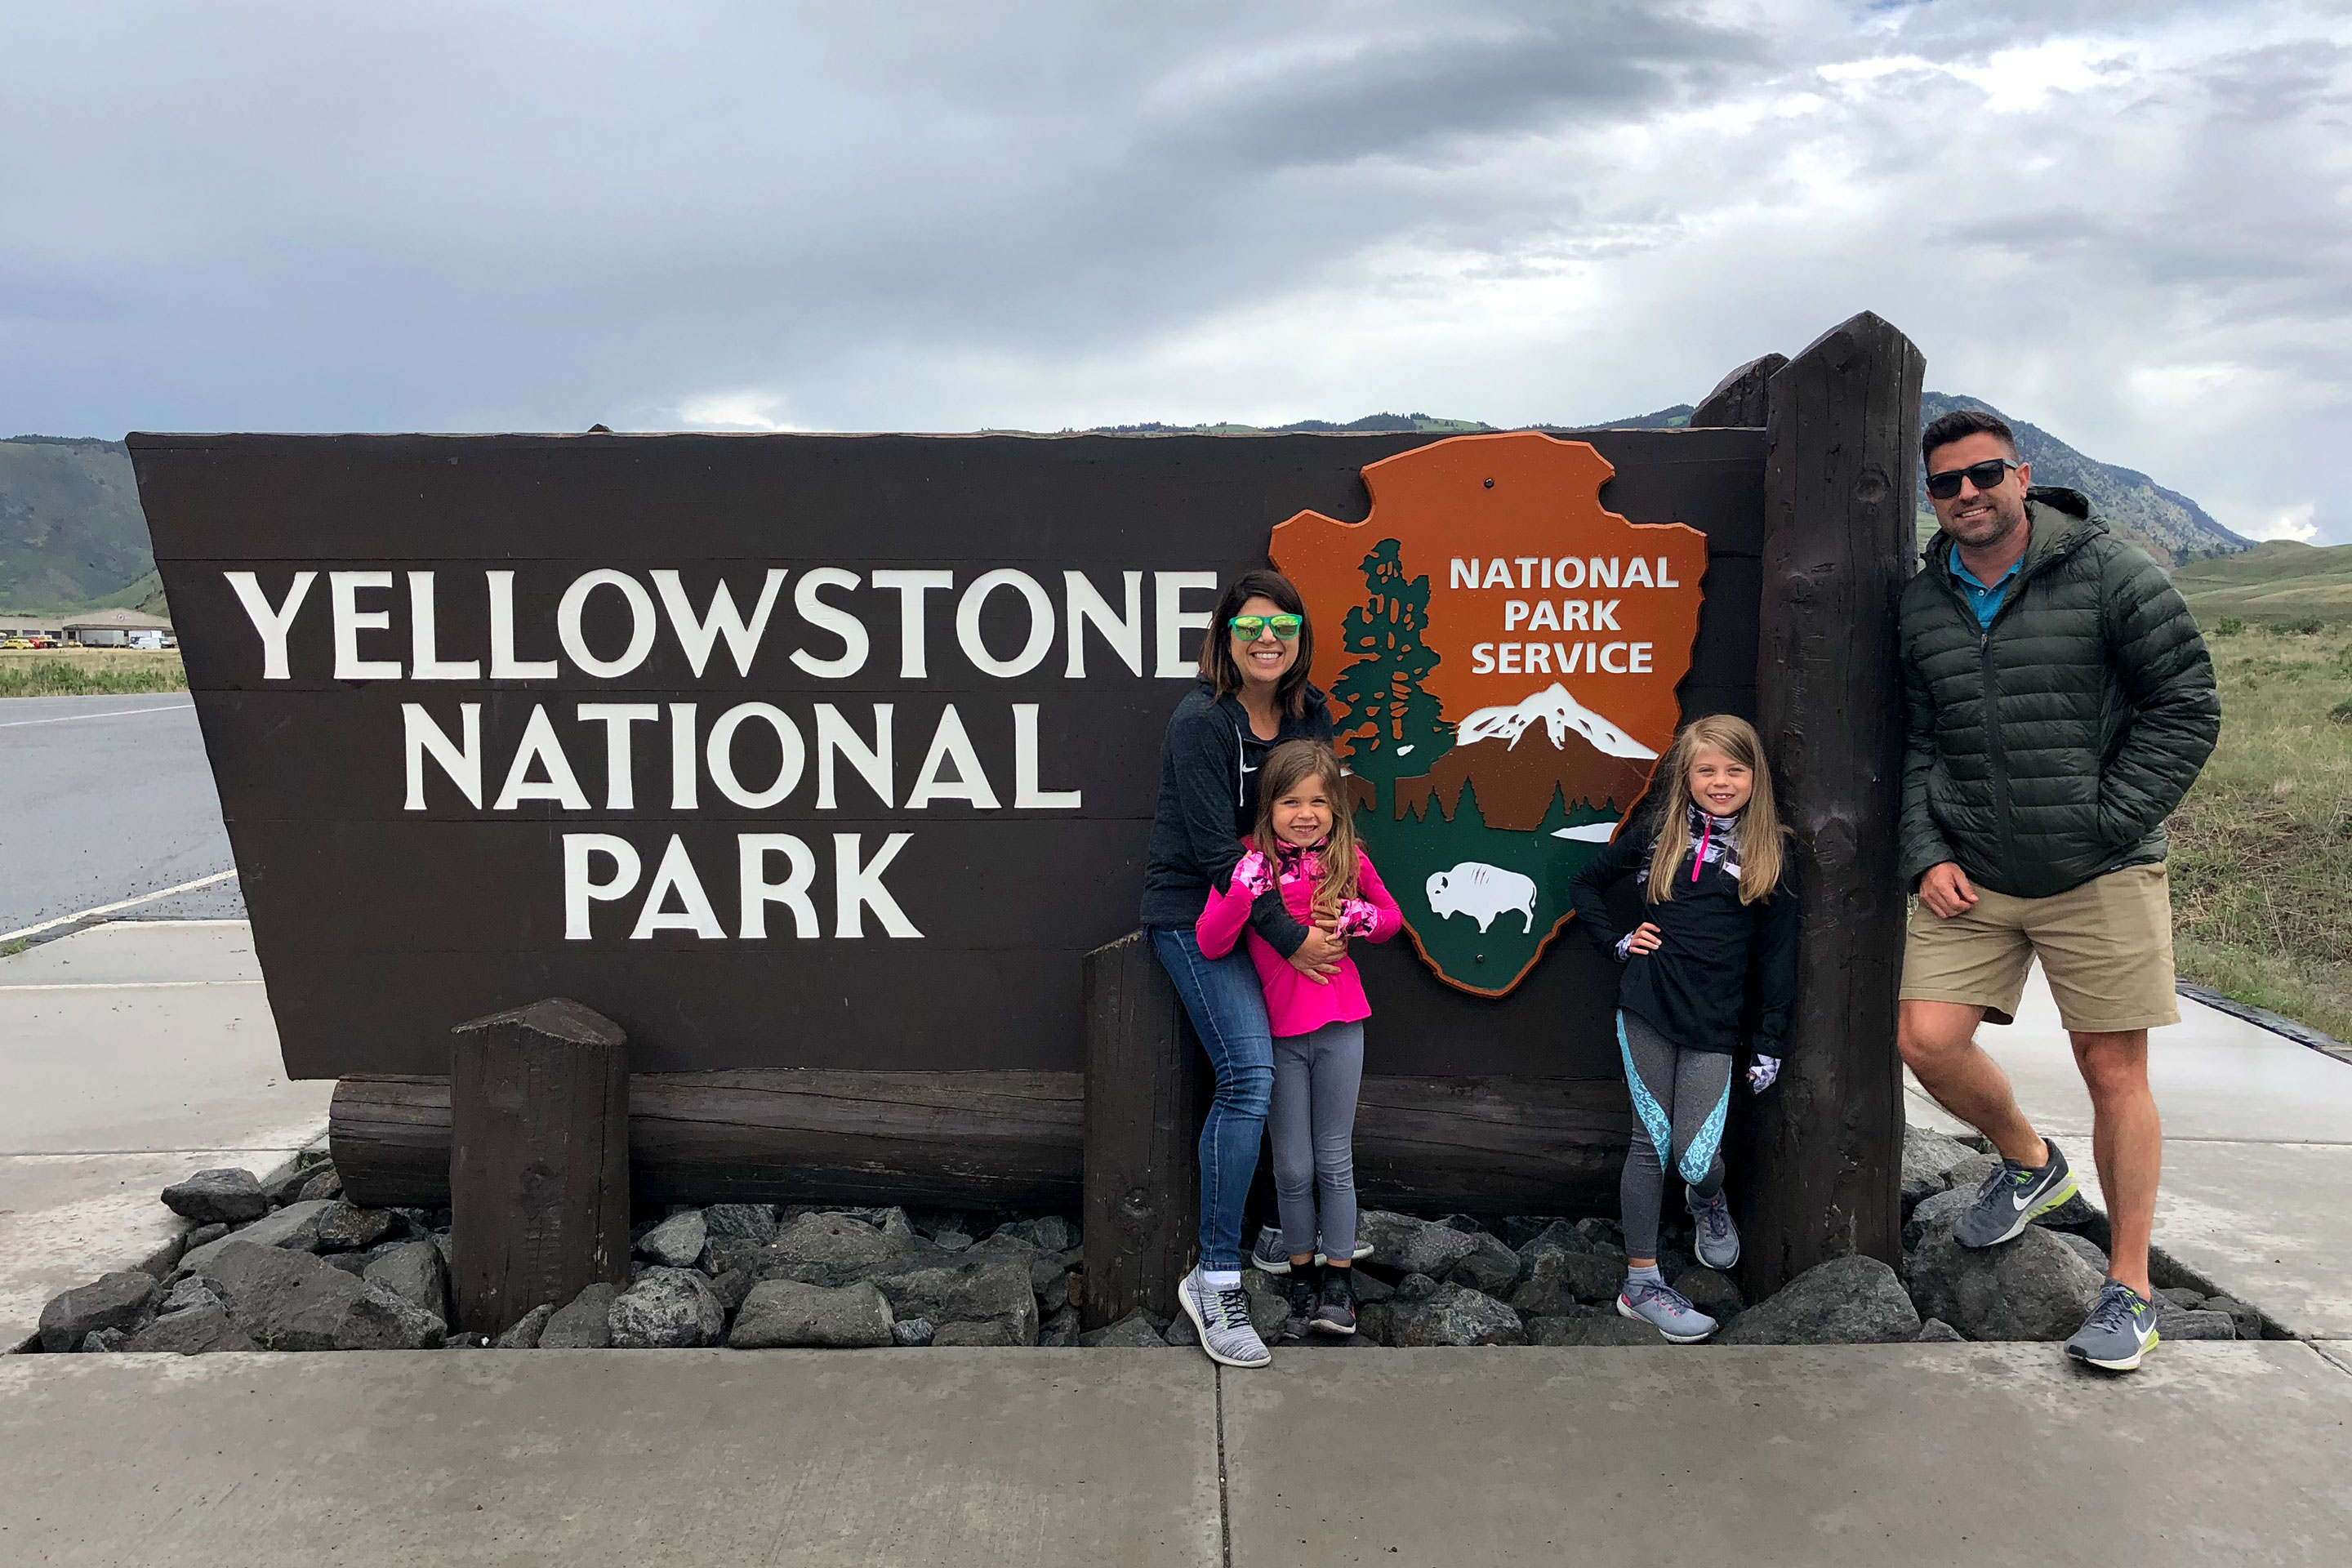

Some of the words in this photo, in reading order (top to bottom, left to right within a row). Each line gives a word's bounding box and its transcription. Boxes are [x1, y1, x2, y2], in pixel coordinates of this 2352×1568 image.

[1450, 556, 1679, 589] NATIONAL
[223, 567, 1218, 680] YELLOWSTONE
[1504, 599, 1622, 631] PARK
[1472, 642, 1653, 675] SERVICE
[401, 702, 1081, 810] NATIONAL
[561, 832, 925, 941] PARK
